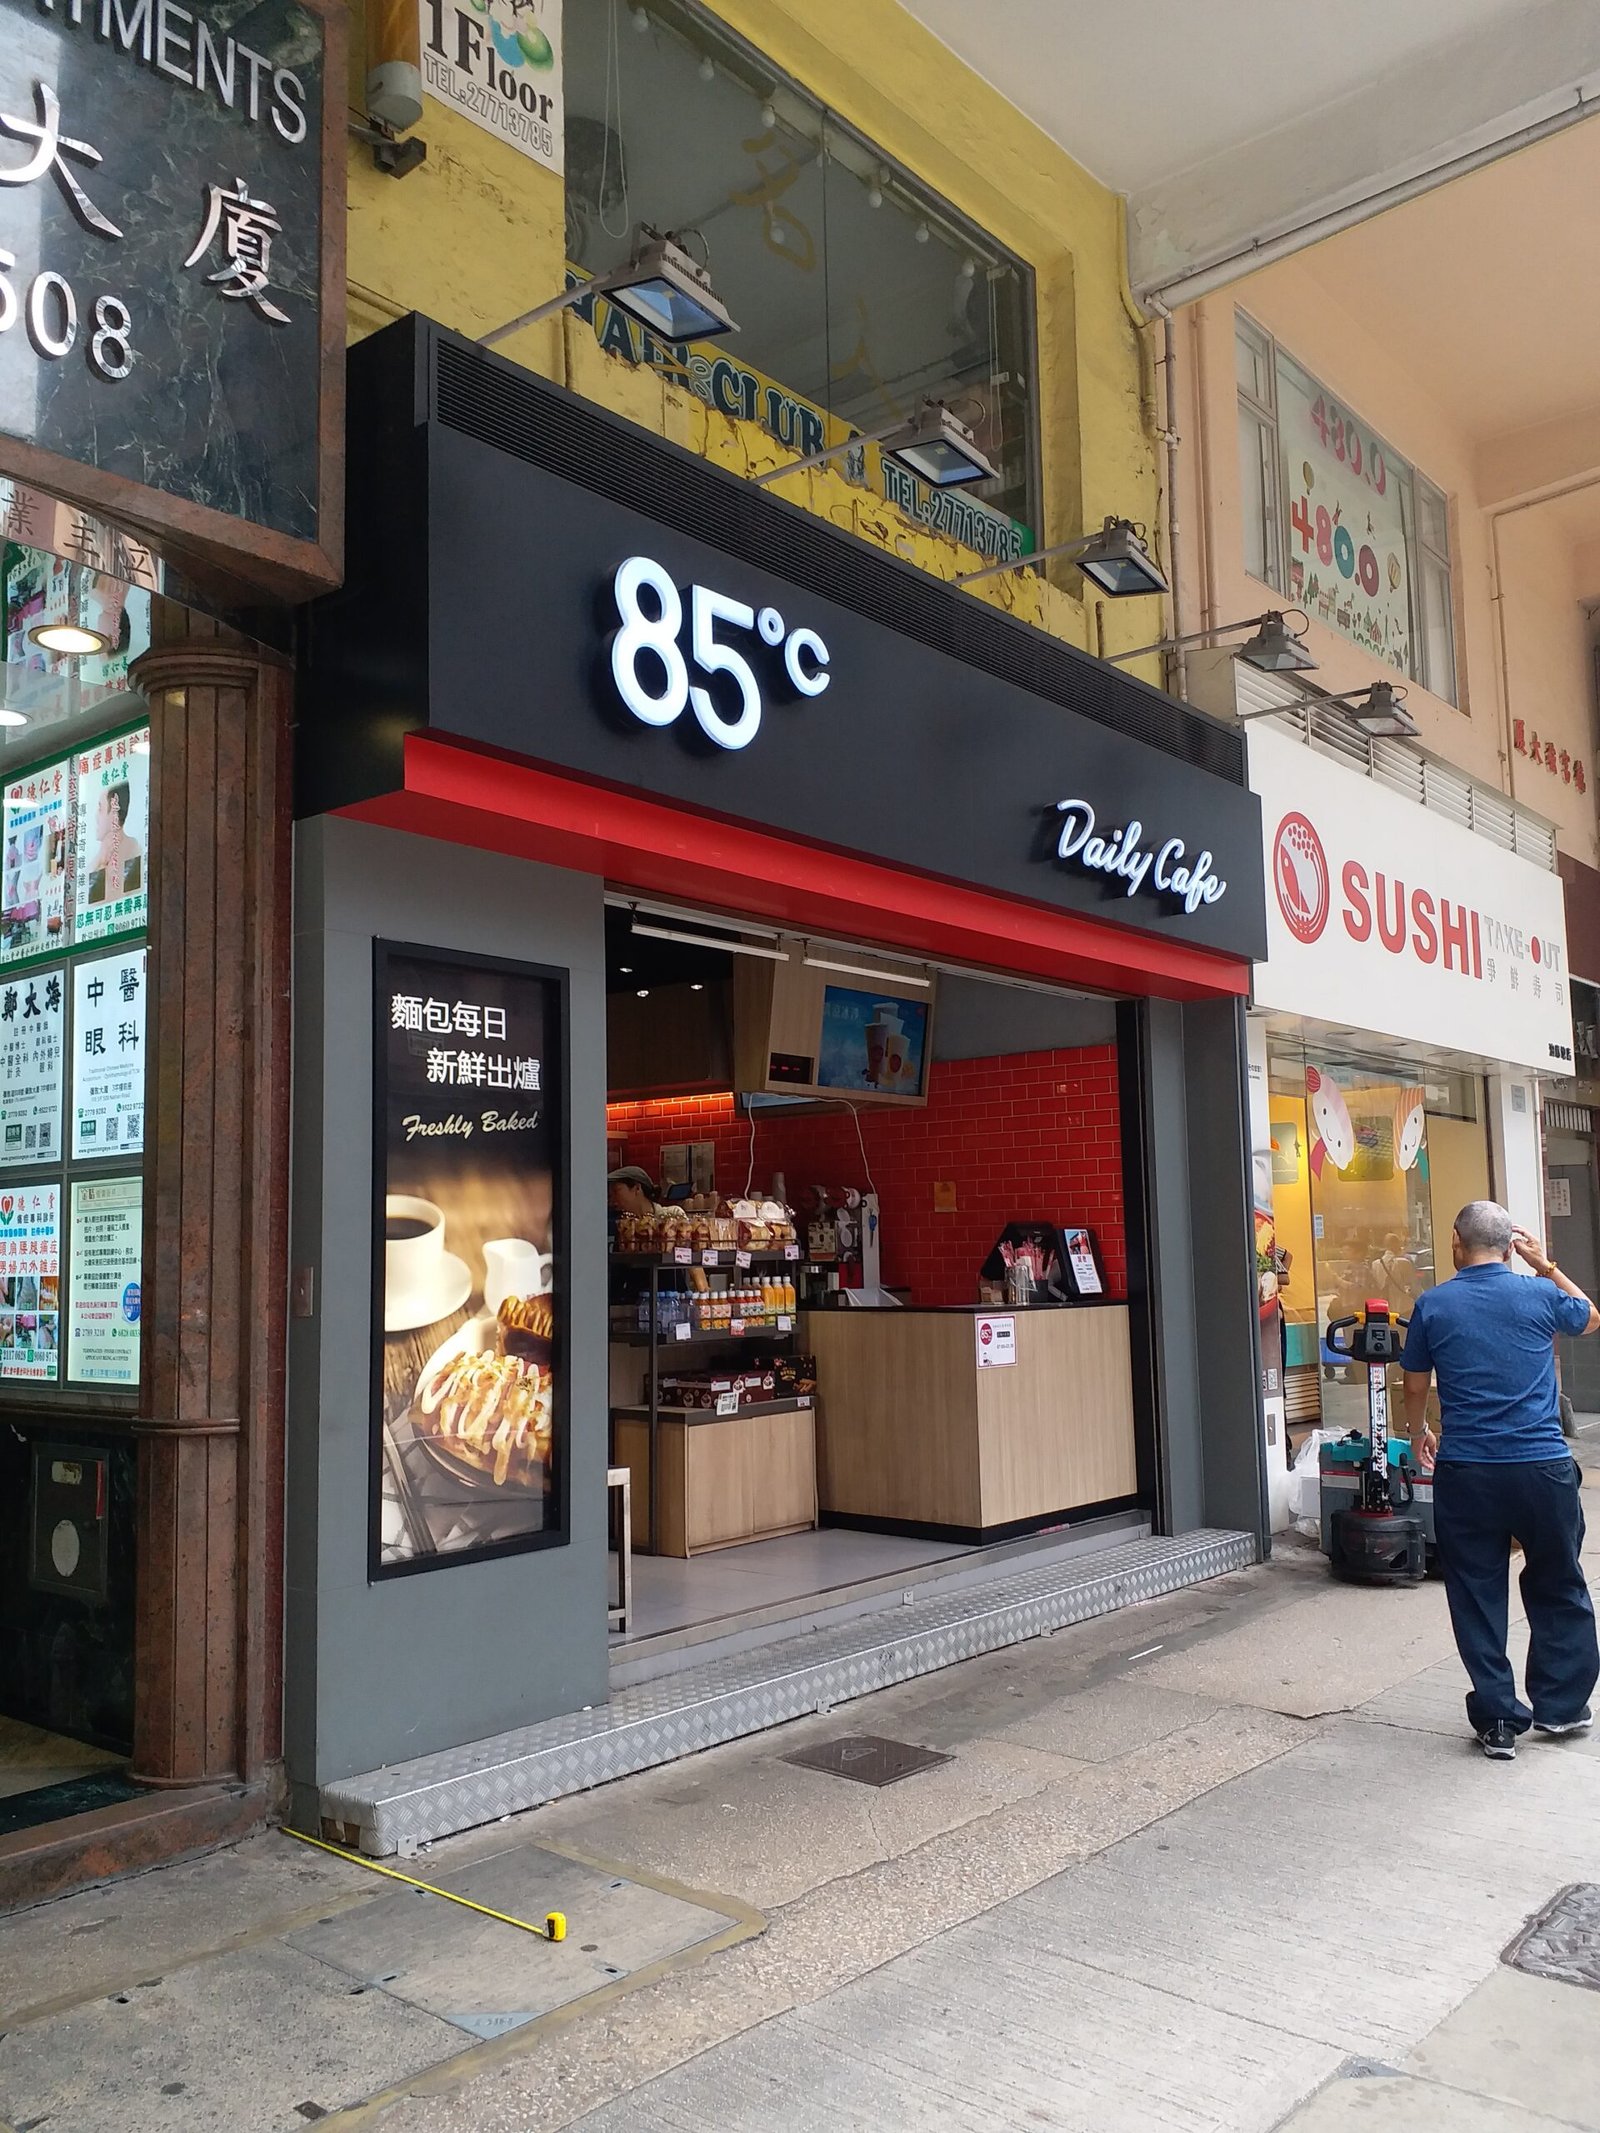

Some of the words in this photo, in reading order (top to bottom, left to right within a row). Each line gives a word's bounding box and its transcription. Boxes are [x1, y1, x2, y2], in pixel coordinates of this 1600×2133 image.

[1291, 496, 1379, 597] 480.0
[1057, 799, 1154, 897] Daily
[1155, 838, 1227, 914] Cafe
[1342, 861, 1482, 979] SUSHI
[1483, 915, 1561, 972] TAKE-OUT
[87, 968, 140, 1008] 中醫
[85, 1020, 139, 1056] 眼科
[391, 993, 507, 1041] 麵包每日
[426, 1047, 541, 1091] 新鮮出爐
[402, 1113, 474, 1142] Freshly
[480, 1110, 539, 1133] Baked
